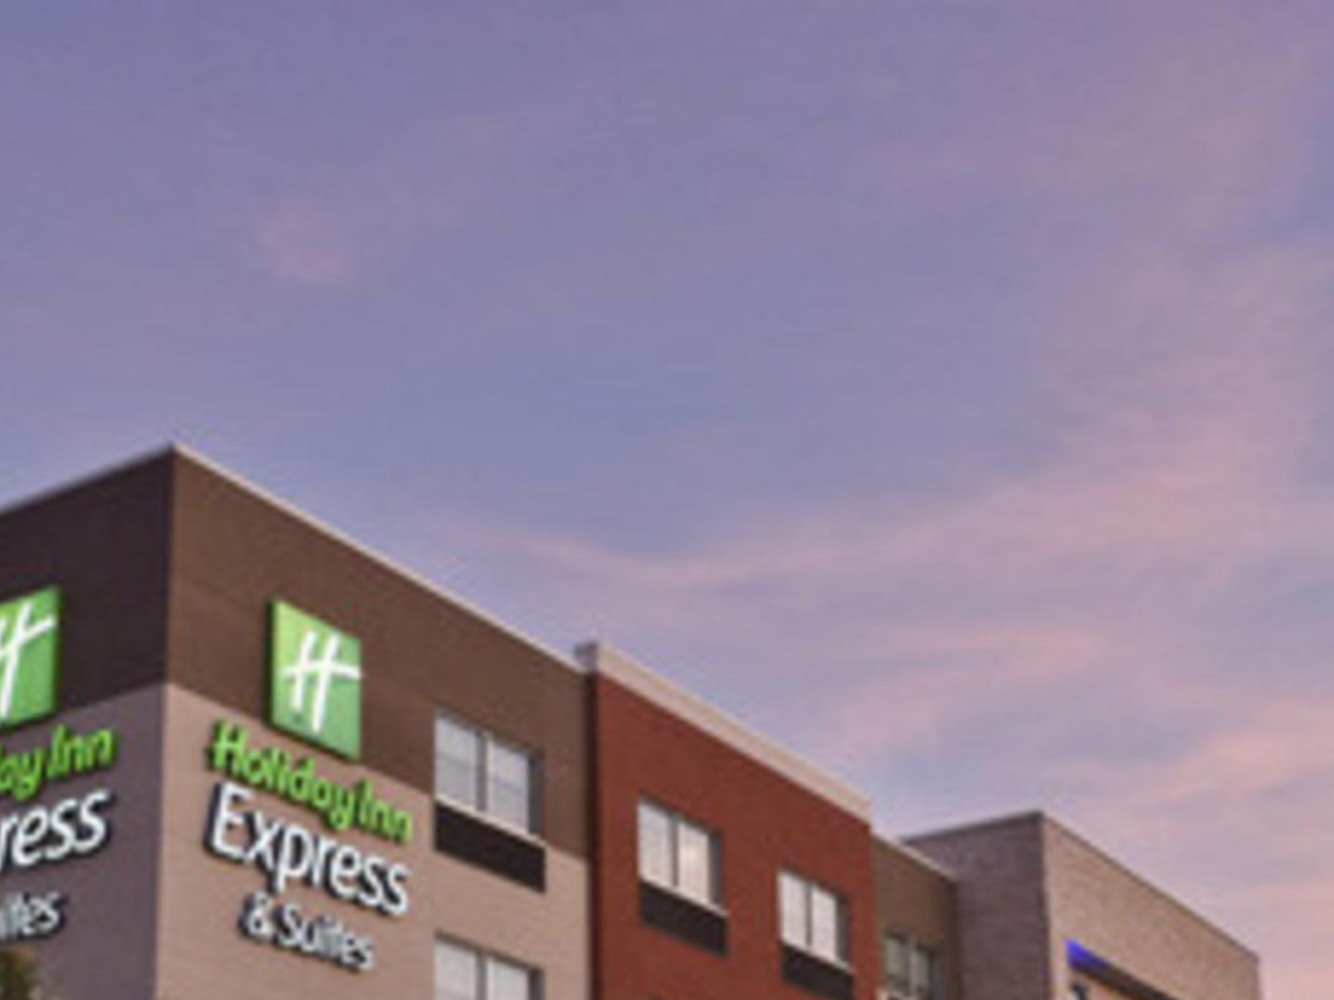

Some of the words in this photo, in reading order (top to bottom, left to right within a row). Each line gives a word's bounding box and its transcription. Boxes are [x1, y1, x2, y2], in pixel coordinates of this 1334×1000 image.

[45, 725, 116, 779] Inn
[210, 720, 354, 831] Holiday
[357, 780, 414, 842] Inn
[210, 782, 409, 917] Express
[244, 891, 272, 936] &
[277, 903, 374, 970] Suites
